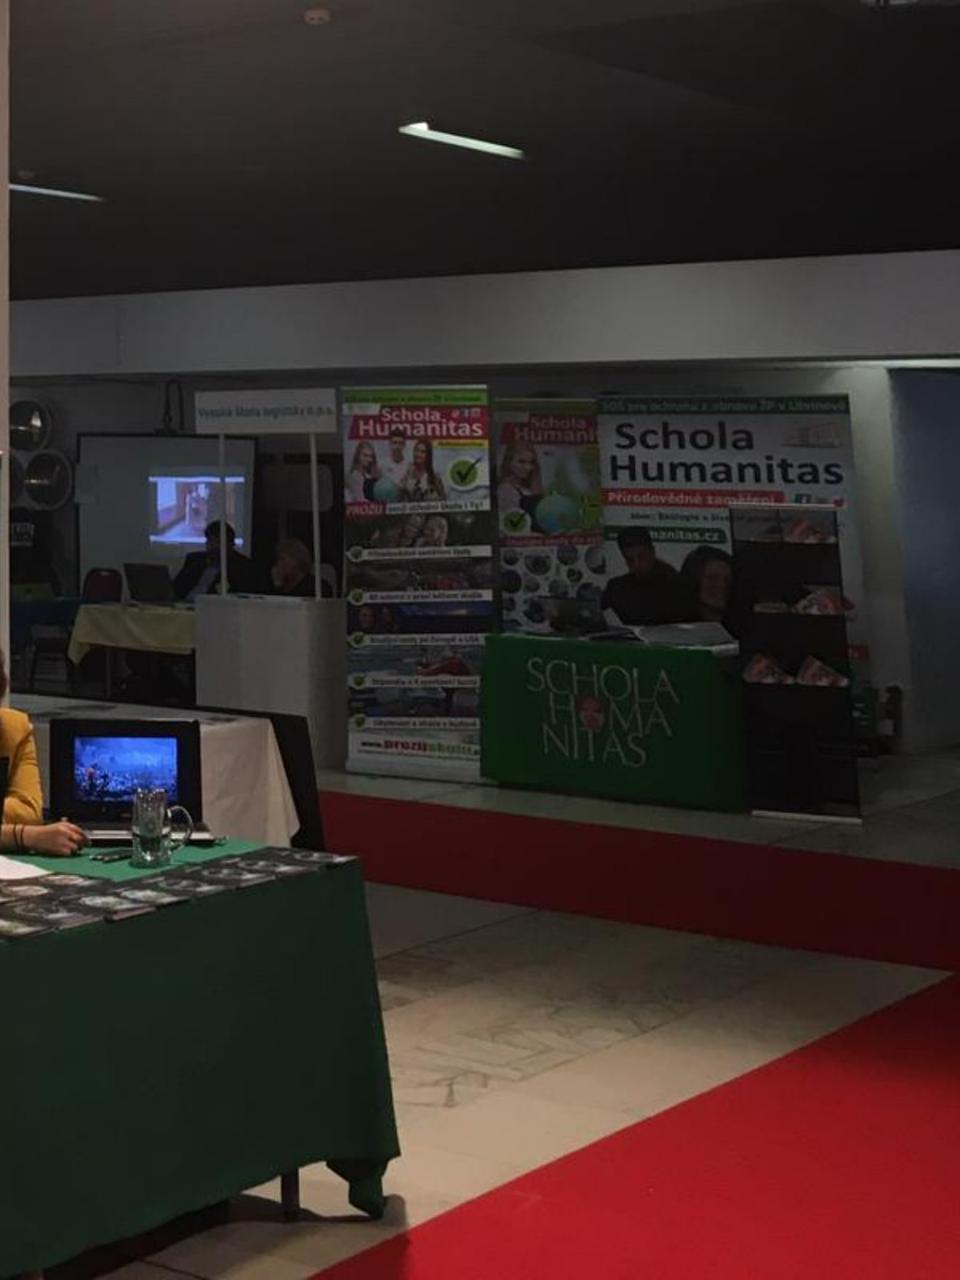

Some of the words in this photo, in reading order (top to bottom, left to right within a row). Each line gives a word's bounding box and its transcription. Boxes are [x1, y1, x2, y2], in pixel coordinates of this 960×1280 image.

[381, 408, 440, 421] Schola
[532, 414, 587, 429] Schola
[359, 419, 483, 436] Humanitas
[514, 426, 595, 441] Humani
[615, 421, 754, 450] Schola
[610, 454, 843, 485] Humanitas
[527, 657, 680, 704] SCHOLA
[542, 721, 647, 768] NITAS
